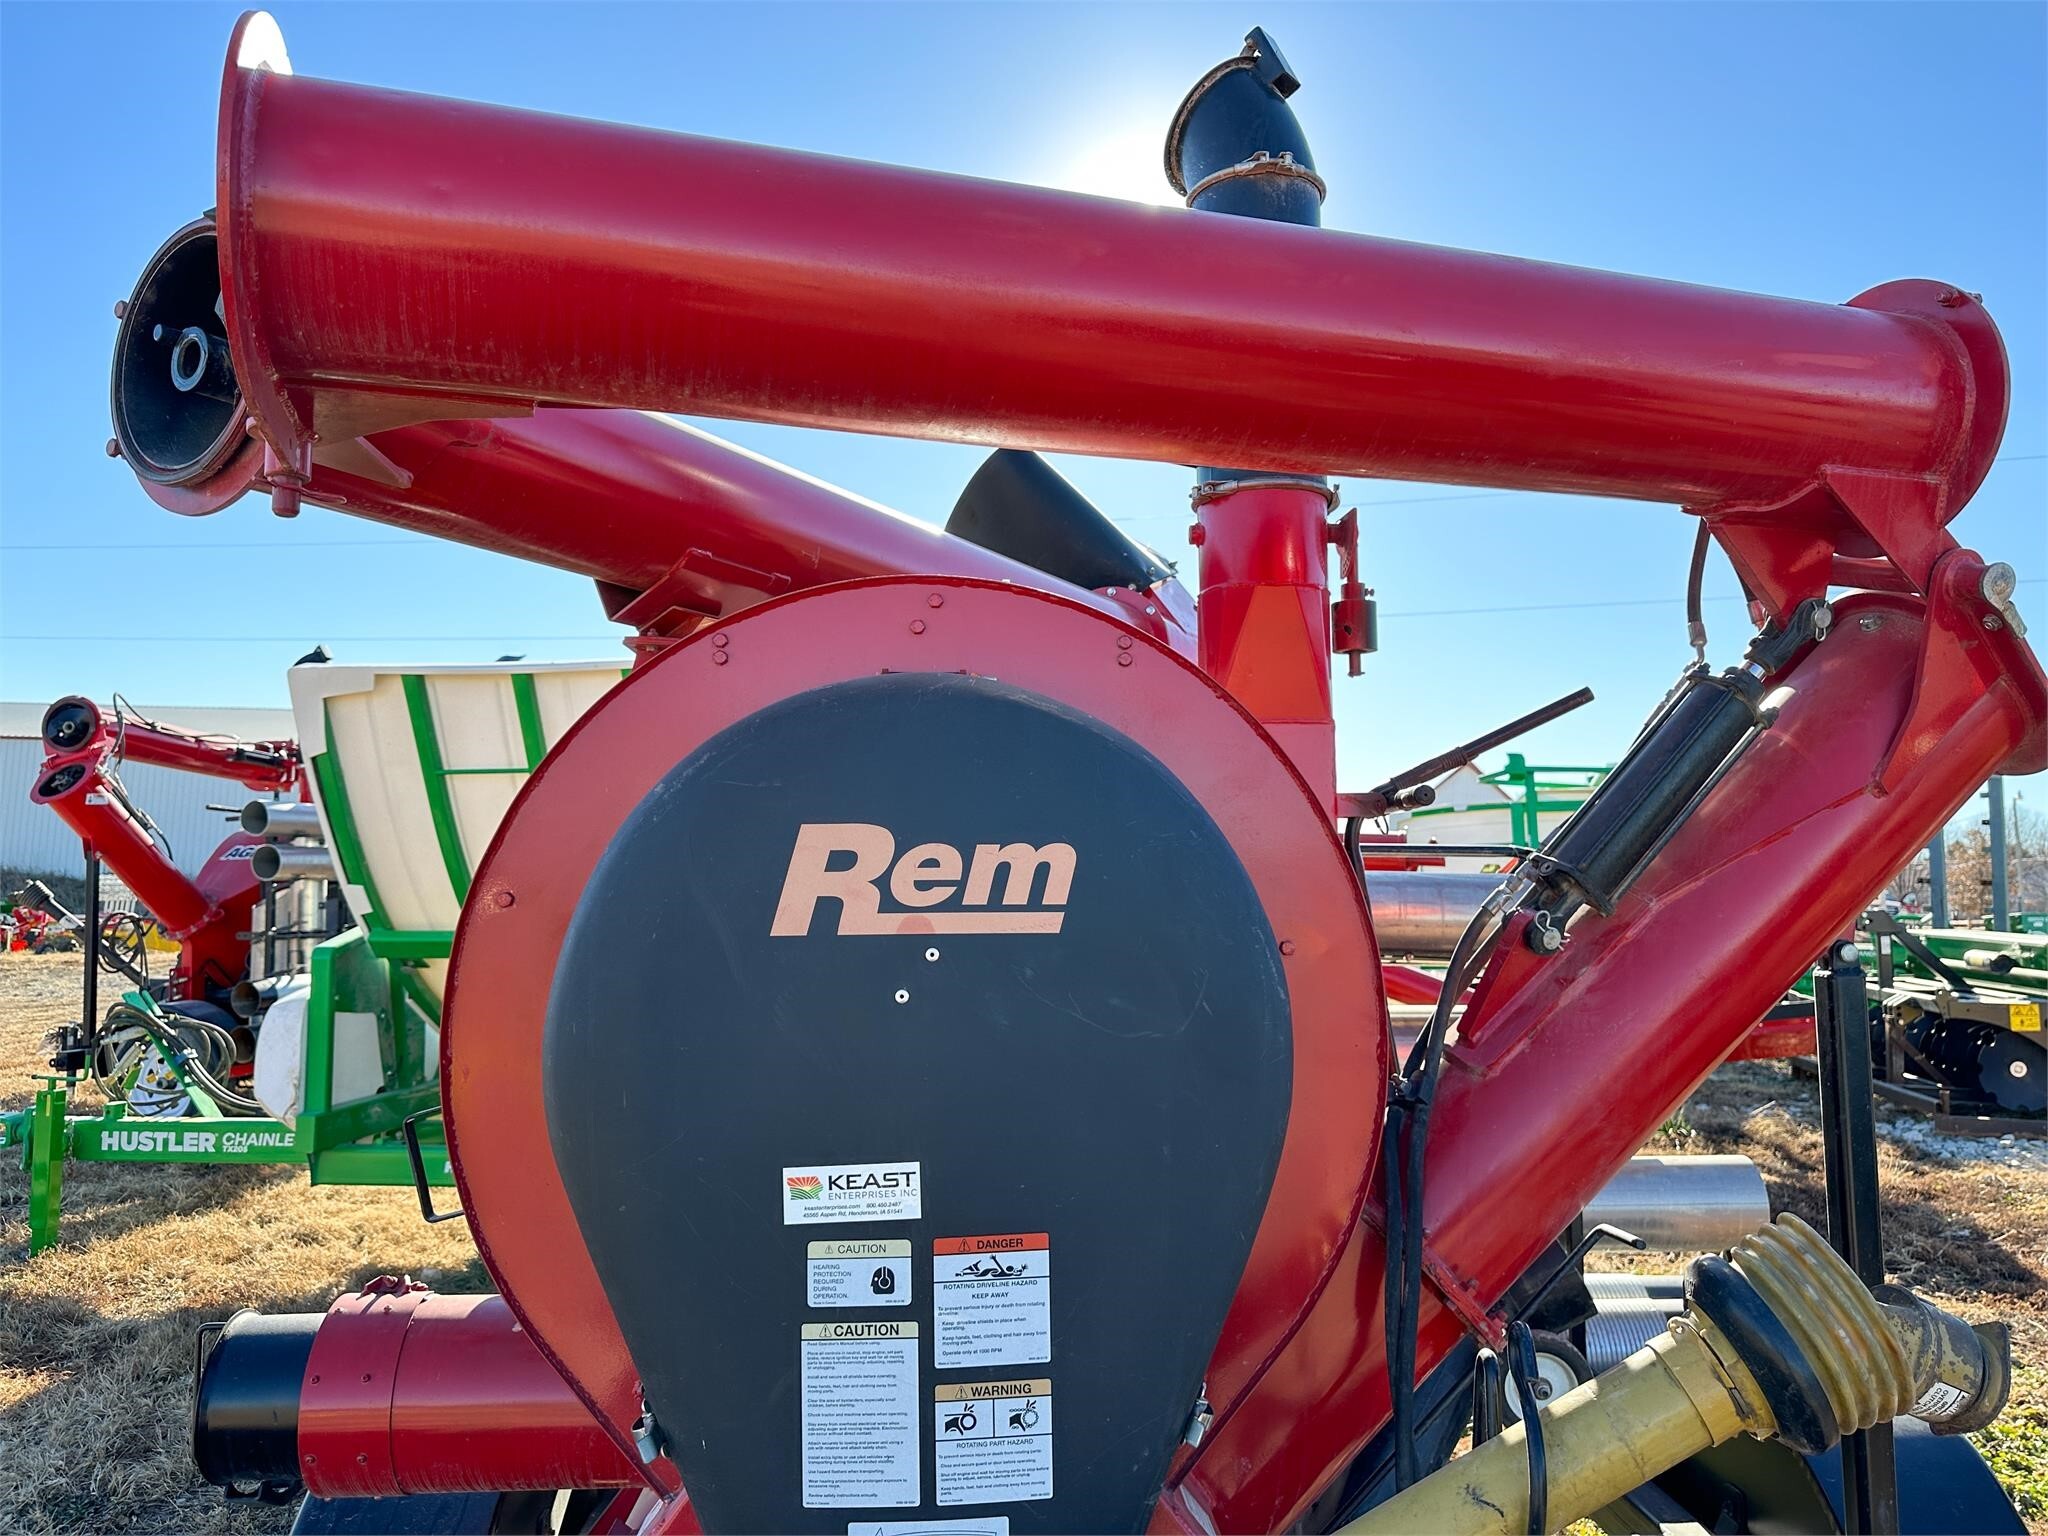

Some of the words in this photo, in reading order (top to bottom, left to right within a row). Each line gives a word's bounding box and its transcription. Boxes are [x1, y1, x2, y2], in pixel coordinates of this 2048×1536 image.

[769, 822, 1078, 937] Rem
[101, 1130, 216, 1152] HUSTLER
[222, 1132, 295, 1147] CHAINLE
[828, 1171, 917, 1191] KEAST
[828, 1190, 897, 1200] ENTERPRISES
[900, 1188, 918, 1197] INC
[804, 1203, 861, 1211] keastenterprises.com
[848, 1209, 880, 1217] Henderson,
[837, 1244, 887, 1254] CAUTION
[976, 1238, 1024, 1250] DANGER
[977, 1281, 1009, 1289] DRIVELINE
[833, 1324, 900, 1337] CAUTION
[971, 1383, 1032, 1397] WARNING
[1007, 1438, 1034, 1446] HAZARD
